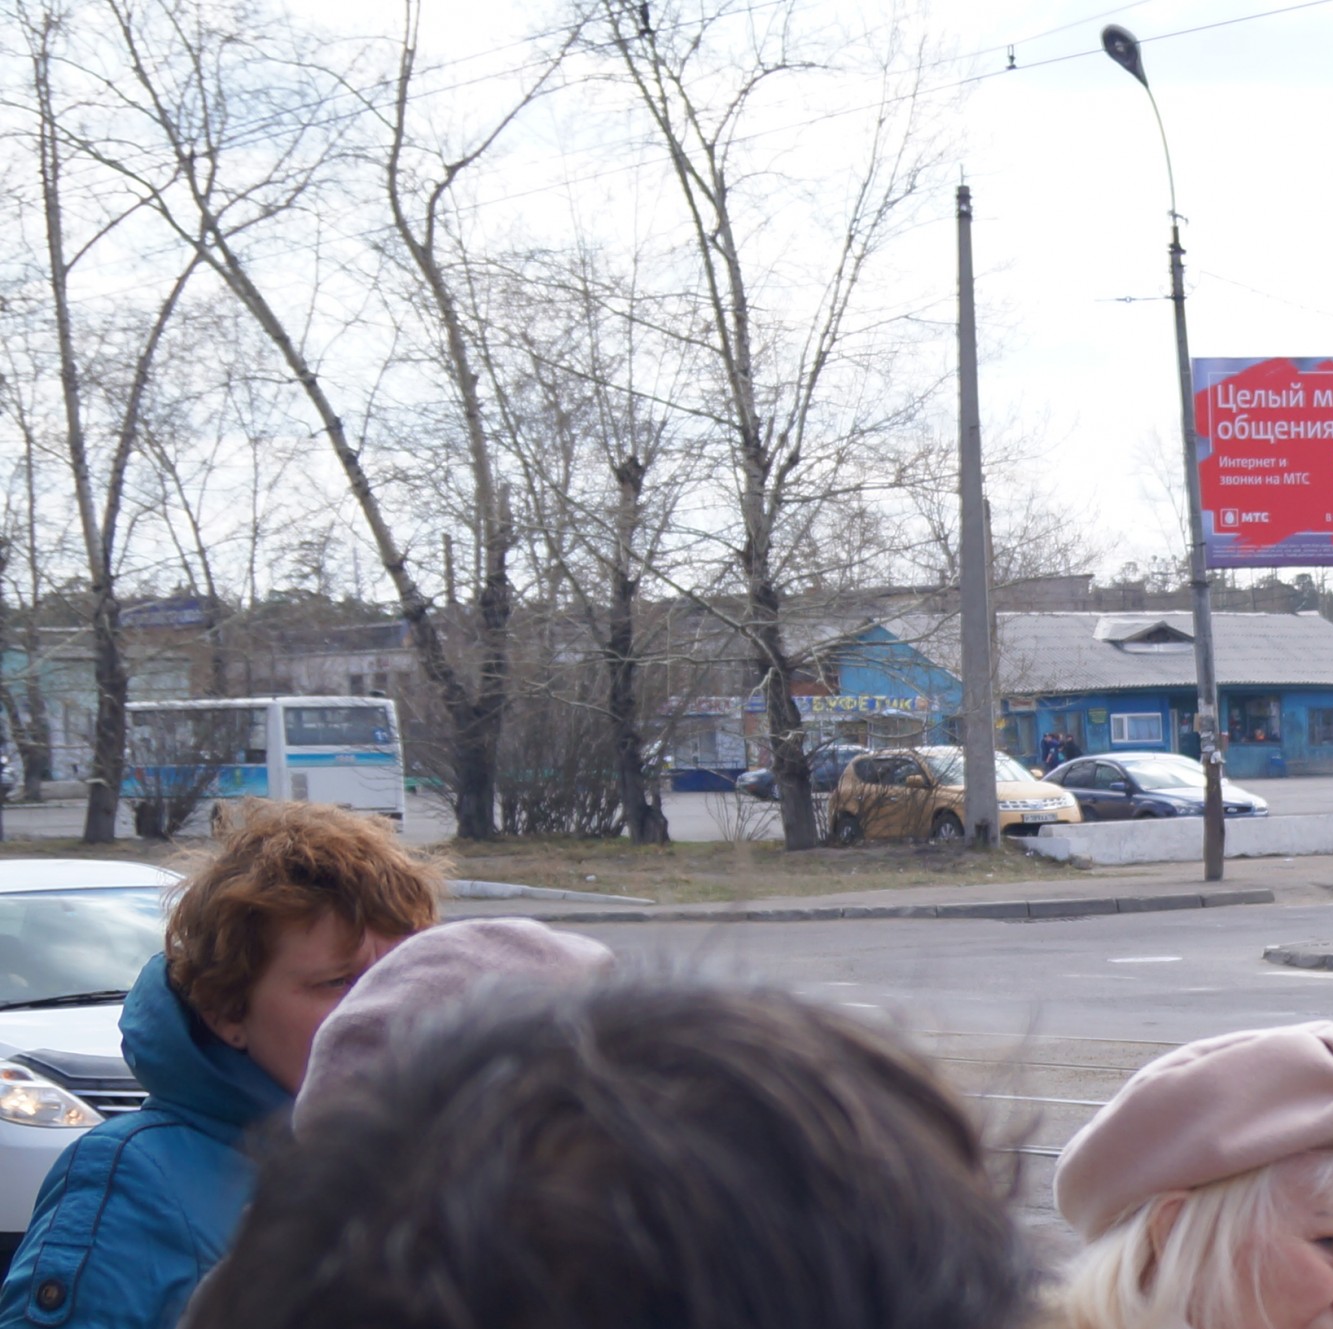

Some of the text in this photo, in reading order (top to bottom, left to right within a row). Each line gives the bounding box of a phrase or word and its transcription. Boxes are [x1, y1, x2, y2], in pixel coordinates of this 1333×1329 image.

[1217, 382, 1304, 413] Целый
[1219, 456, 1287, 469] Интернет и
[1219, 472, 1310, 486] звонки на МТС
[1241, 511, 1270, 523] МТС
[1325, 512, 1332, 522] В
